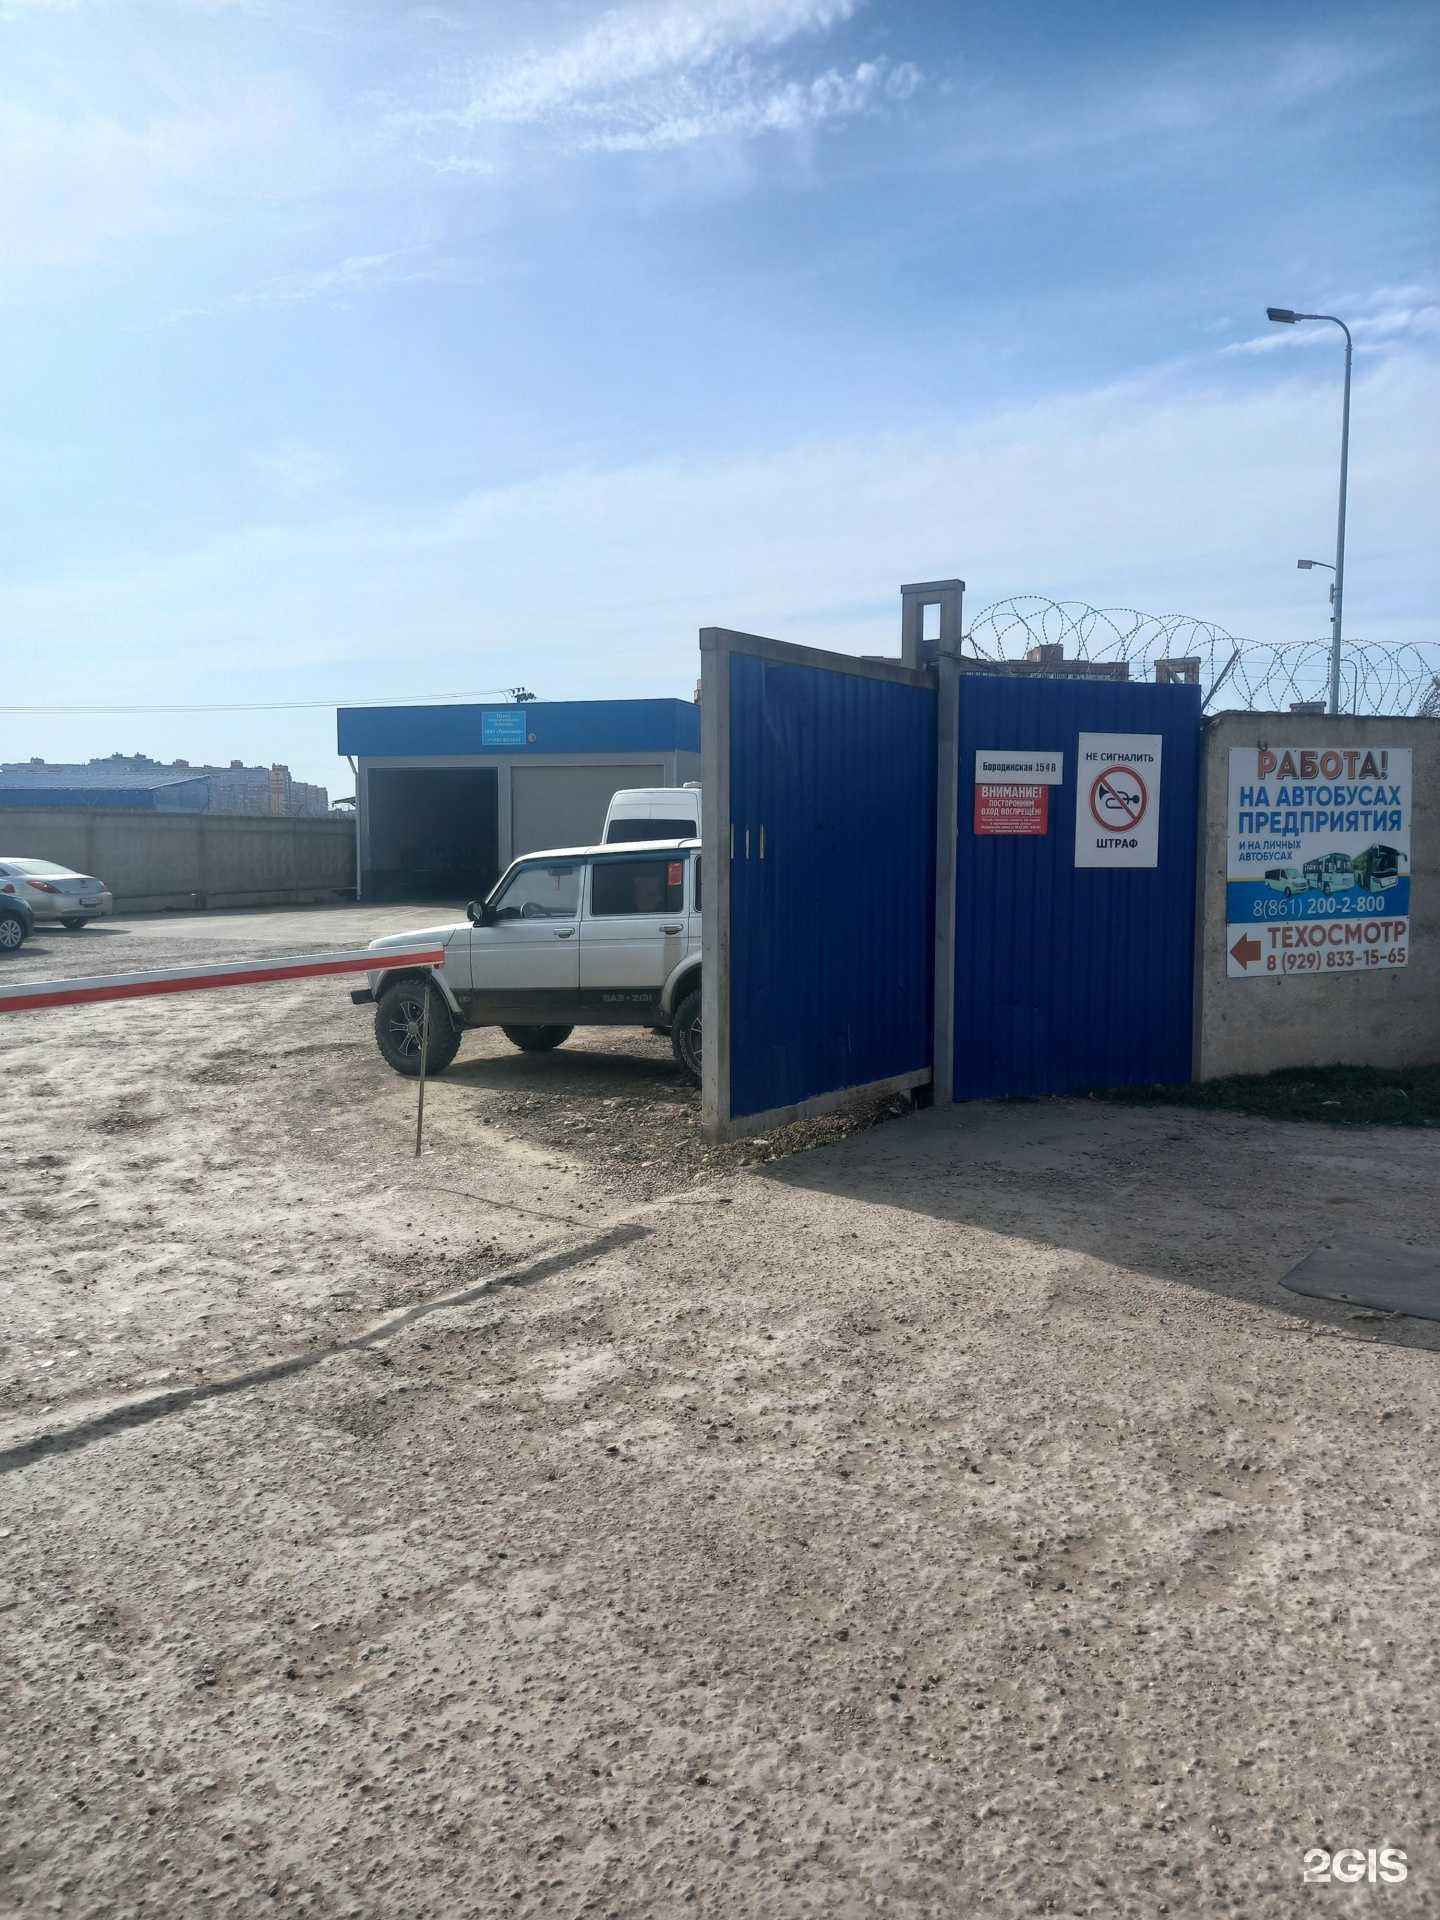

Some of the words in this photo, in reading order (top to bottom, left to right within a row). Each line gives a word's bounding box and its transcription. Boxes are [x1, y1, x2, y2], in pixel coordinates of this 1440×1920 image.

[1086, 752, 1099, 762] НЕ
[1101, 752, 1155, 763] СИГНАЛИТЬ
[1257, 750, 1389, 780] РАБОТА!
[982, 761, 1033, 773] Бородинская
[981, 786, 1042, 799] ВНИМАНИЕ!
[1239, 786, 1271, 807] НА
[1276, 785, 1401, 807] АВТОБУСАХ
[1238, 810, 1402, 836] ПРЕДПРИЯТИЯ
[1096, 838, 1138, 849] ШТРАФ
[1239, 840, 1246, 850] И
[1248, 840, 1261, 850] НА
[1263, 839, 1302, 850] ЛИЧНЫХ
[1238, 851, 1293, 861] АВТОБУСАХ
[1252, 899, 1303, 919] 8(861)
[1307, 895, 1385, 915] 200-2-800
[1267, 921, 1406, 949] ТЕХОСМОТР
[1266, 956, 1277, 971] 8
[1282, 951, 1322, 975] (929)
[1326, 947, 1406, 968] 833-15-65
